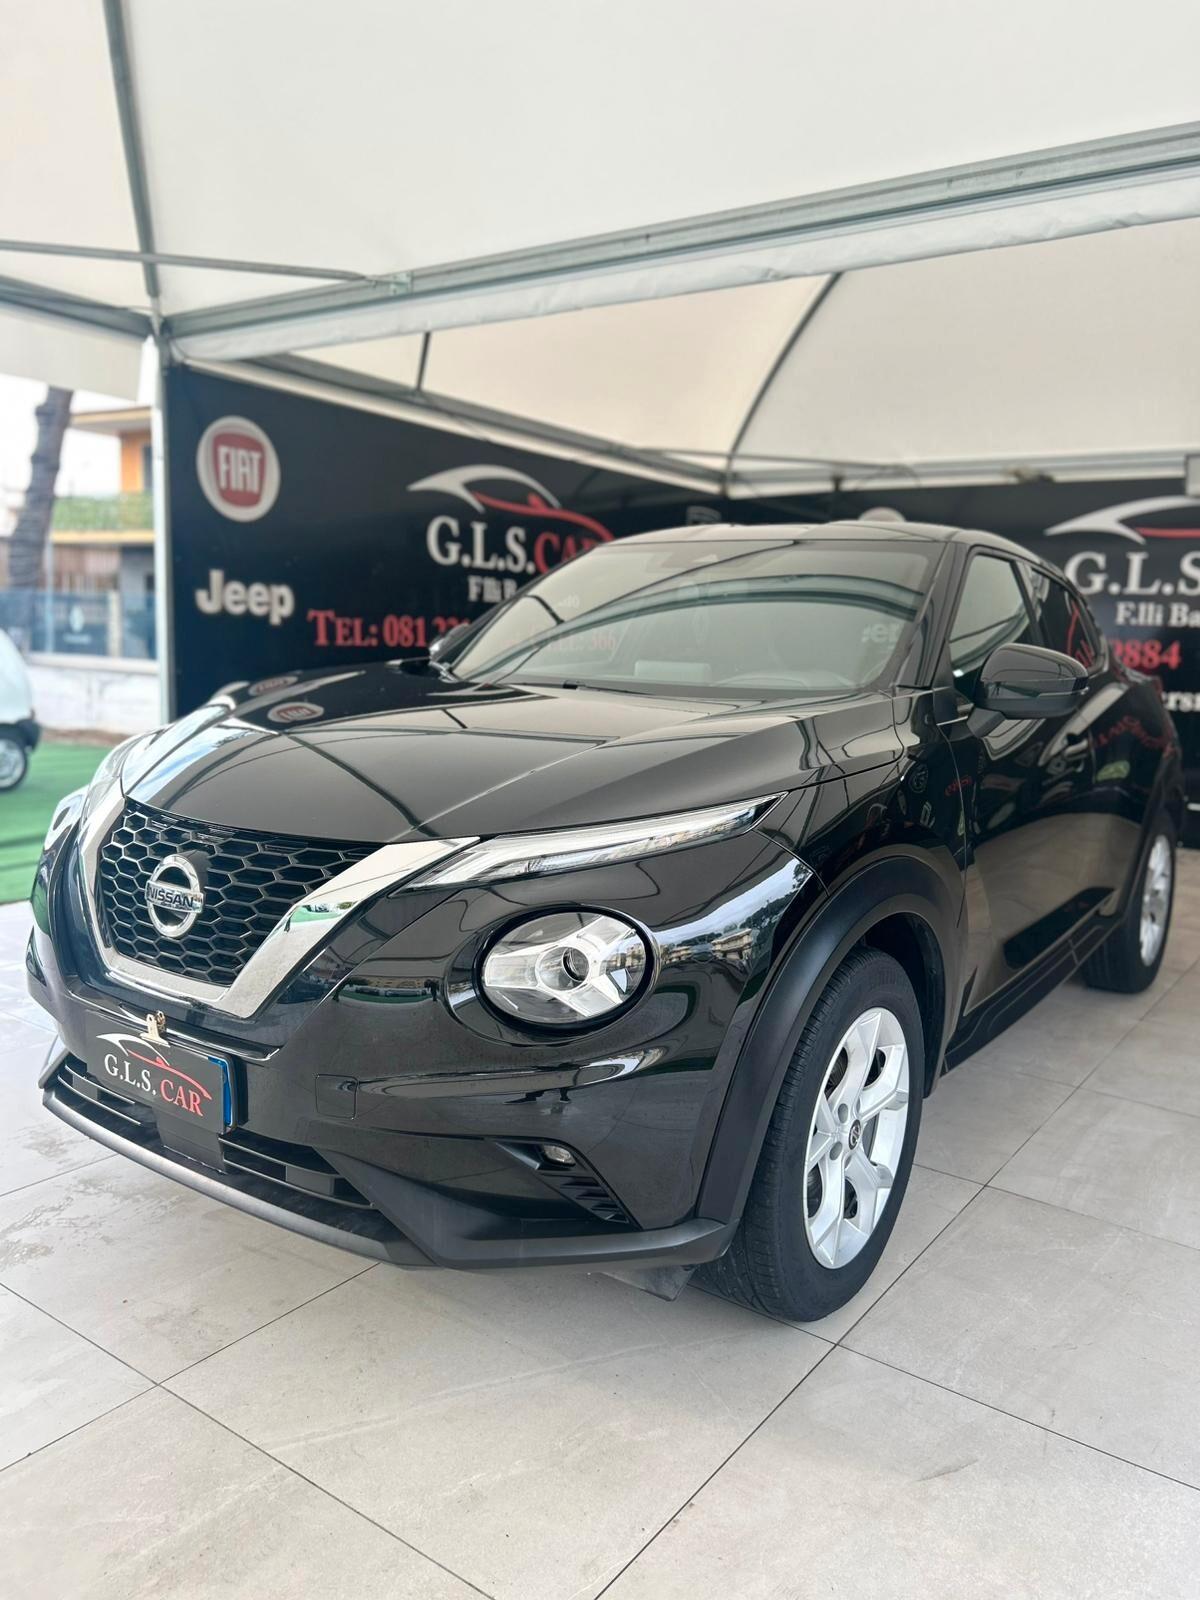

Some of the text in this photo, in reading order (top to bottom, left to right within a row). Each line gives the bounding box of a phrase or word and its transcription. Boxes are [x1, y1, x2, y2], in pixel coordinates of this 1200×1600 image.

[218, 444, 262, 493] FIAT
[196, 569, 294, 626] Jeep
[382, 614, 427, 648] 081
[149, 885, 194, 908] NISSAN
[160, 1079, 204, 1117] CAR
